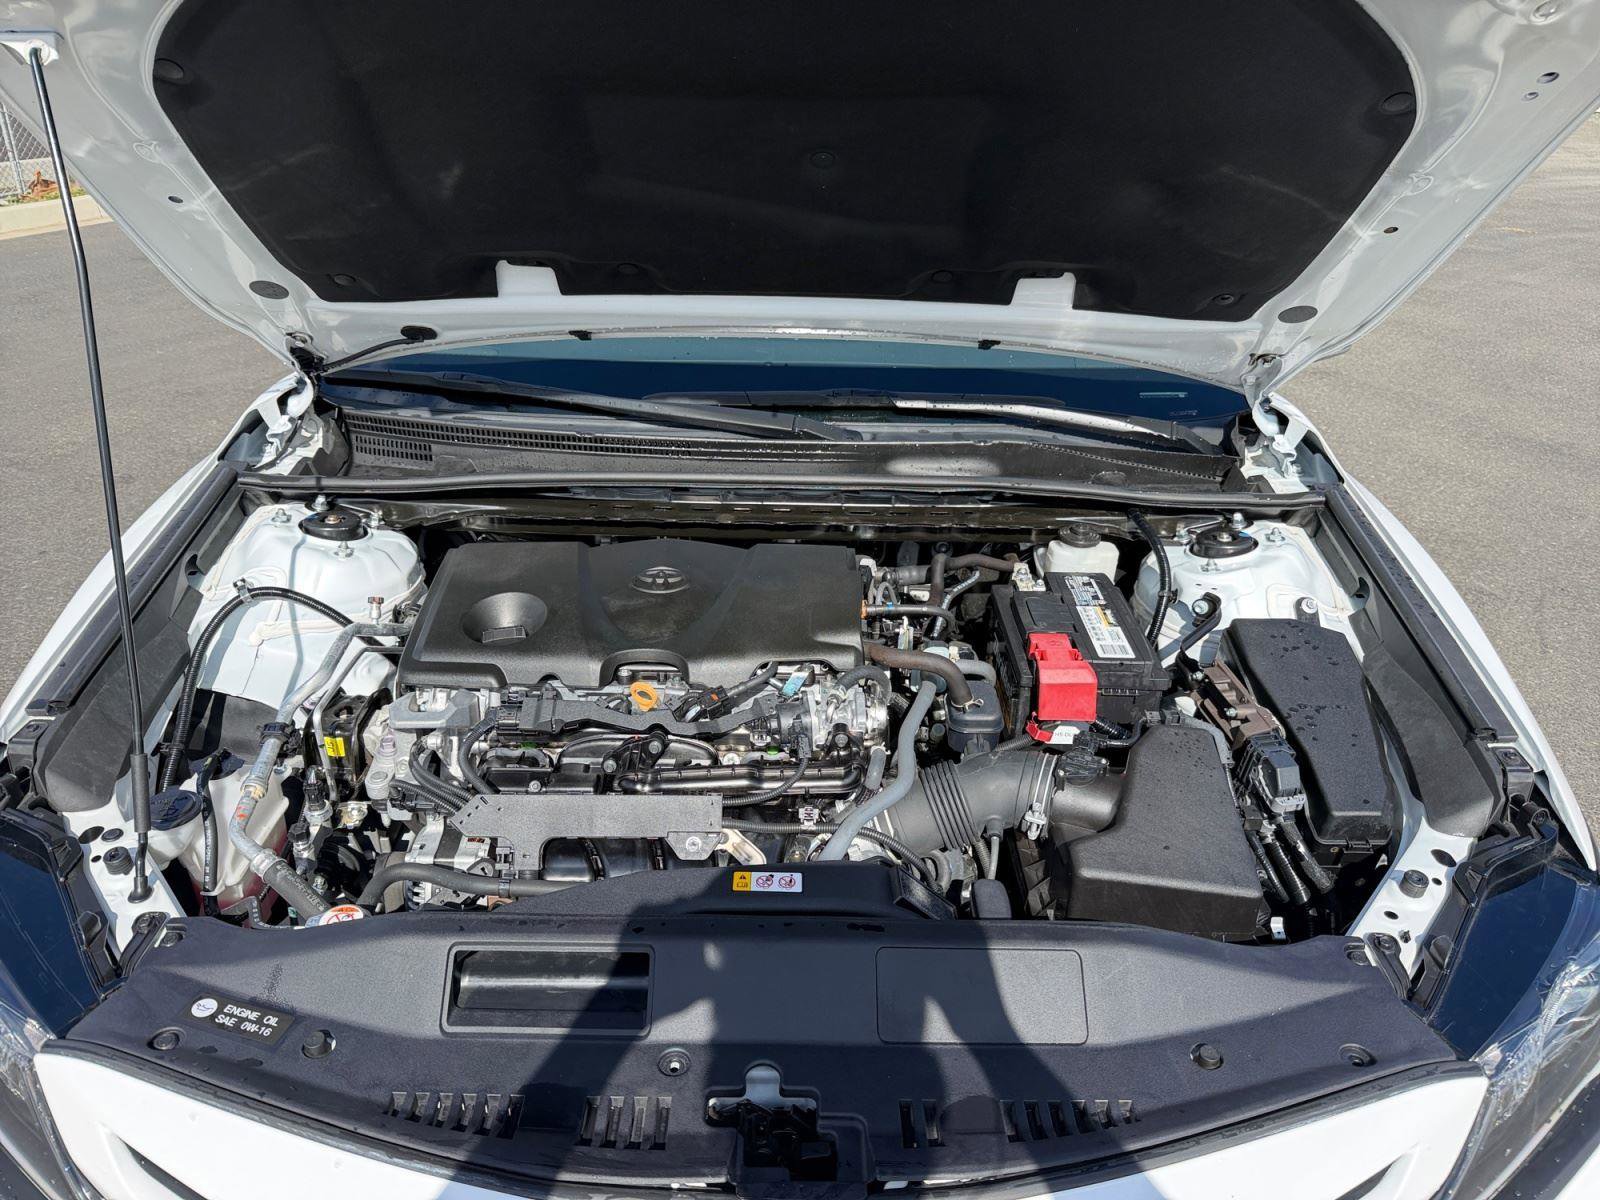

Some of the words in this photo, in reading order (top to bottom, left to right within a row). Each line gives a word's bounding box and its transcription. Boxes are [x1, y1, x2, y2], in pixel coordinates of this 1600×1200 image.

[215, 1015, 238, 1026] SAE
[240, 1021, 272, 1036] 0W-16
[224, 1004, 260, 1020] ENGINE
[263, 1015, 279, 1026] OIL
